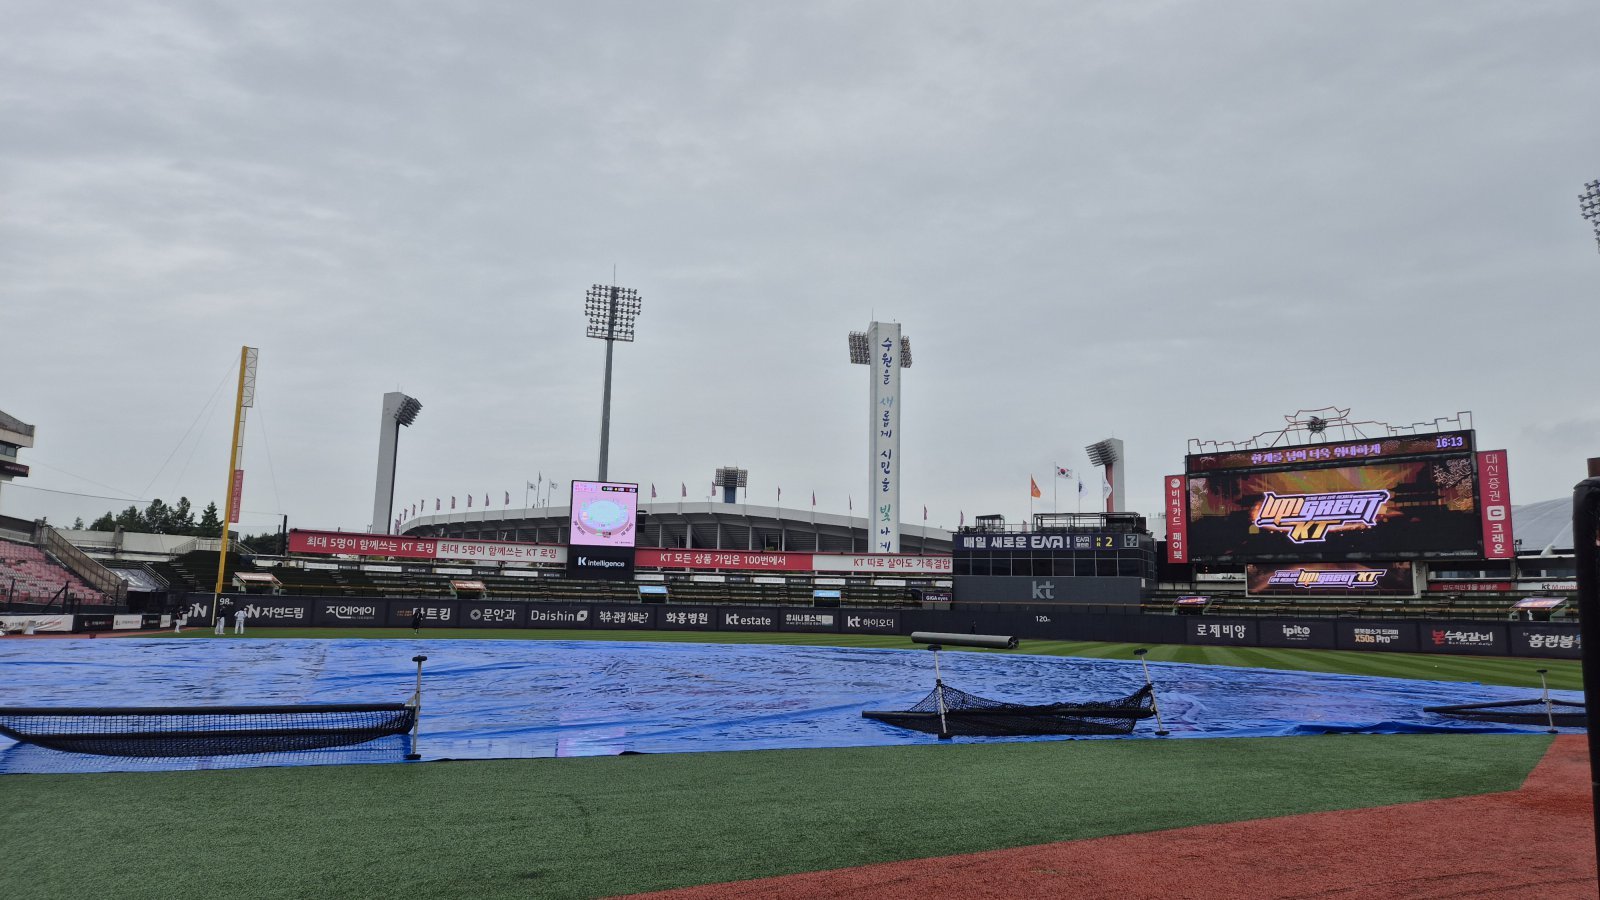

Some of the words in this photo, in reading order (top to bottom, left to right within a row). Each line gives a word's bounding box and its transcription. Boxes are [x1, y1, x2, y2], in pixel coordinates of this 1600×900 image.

[881, 337, 893, 385] 수원을
[1436, 437, 1463, 448] 16:13
[880, 449, 892, 492] 시민을
[1486, 454, 1501, 502] 대신증권
[880, 504, 891, 552] 빛나게
[1284, 519, 1341, 541] KT
[306, 536, 327, 547] 최대
[329, 538, 356, 549] 5명이
[359, 539, 398, 551] 함께쓰는
[401, 542, 414, 551] KT
[416, 542, 435, 554] 로밍
[963, 536, 987, 548] 매일
[991, 536, 1027, 549] 새로운
[1105, 536, 1113, 547] 2
[1491, 523, 1505, 554] 크레온
[440, 544, 459, 553] 최대
[462, 545, 485, 555] 5명이
[488, 547, 523, 557] 함께쓰는
[526, 548, 538, 557] KT
[540, 549, 557, 558] 로밍
[577, 557, 587, 566] K
[587, 559, 625, 568] intelligence
[660, 553, 672, 562] KT
[674, 554, 692, 564] 모든
[694, 554, 712, 565] 상품
[714, 555, 741, 565] 가입은
[744, 556, 786, 566] 100번에서
[853, 559, 864, 567] KT
[867, 559, 884, 567] 따로
[887, 559, 913, 569] 살아도
[916, 559, 951, 570] 가족결합
[1031, 580, 1055, 600] kt
[262, 607, 304, 619] 자연드림
[482, 608, 516, 622] 문안과
[531, 610, 575, 622] Daishin
[665, 612, 709, 625] 화홍병원
[725, 613, 740, 625] kt
[740, 615, 772, 626] estate
[847, 615, 861, 628] kt
[862, 618, 894, 628] 하이오더
[1196, 624, 1247, 639] 로제비앙
[1355, 634, 1375, 643] X50s
[1375, 635, 1390, 644] Pro
